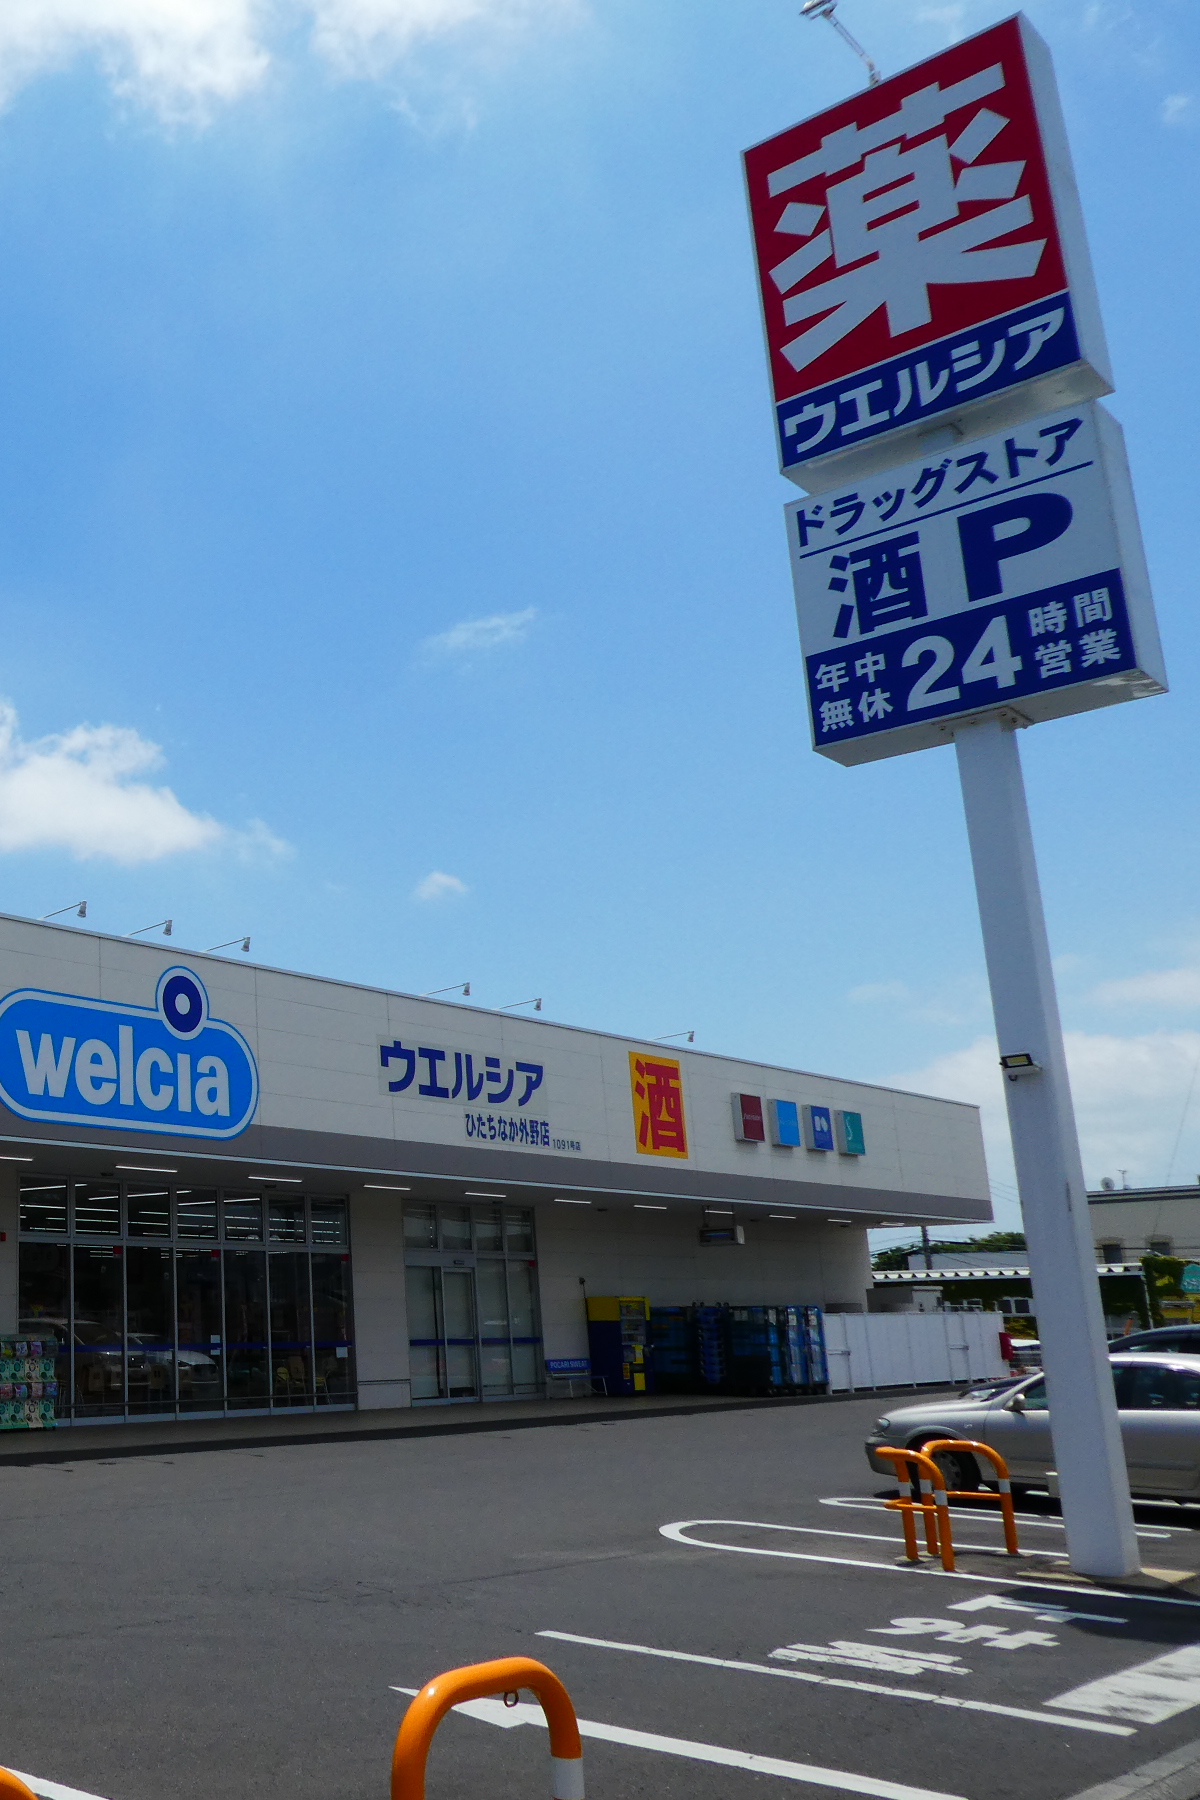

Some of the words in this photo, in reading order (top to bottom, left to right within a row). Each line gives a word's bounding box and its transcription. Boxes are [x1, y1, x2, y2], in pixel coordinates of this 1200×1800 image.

[766, 61, 1048, 373] 薬
[784, 306, 1065, 453] ウエルシア
[798, 417, 1083, 547] ドラッグストア
[827, 530, 929, 641] 酒
[957, 491, 1074, 603] P
[901, 616, 1022, 713] 24
[14, 976, 231, 1117] welcia
[380, 1040, 543, 1106] ウエルシア
[465, 1113, 550, 1147] ひたちなか外野店
[635, 1058, 686, 1153] 酒
